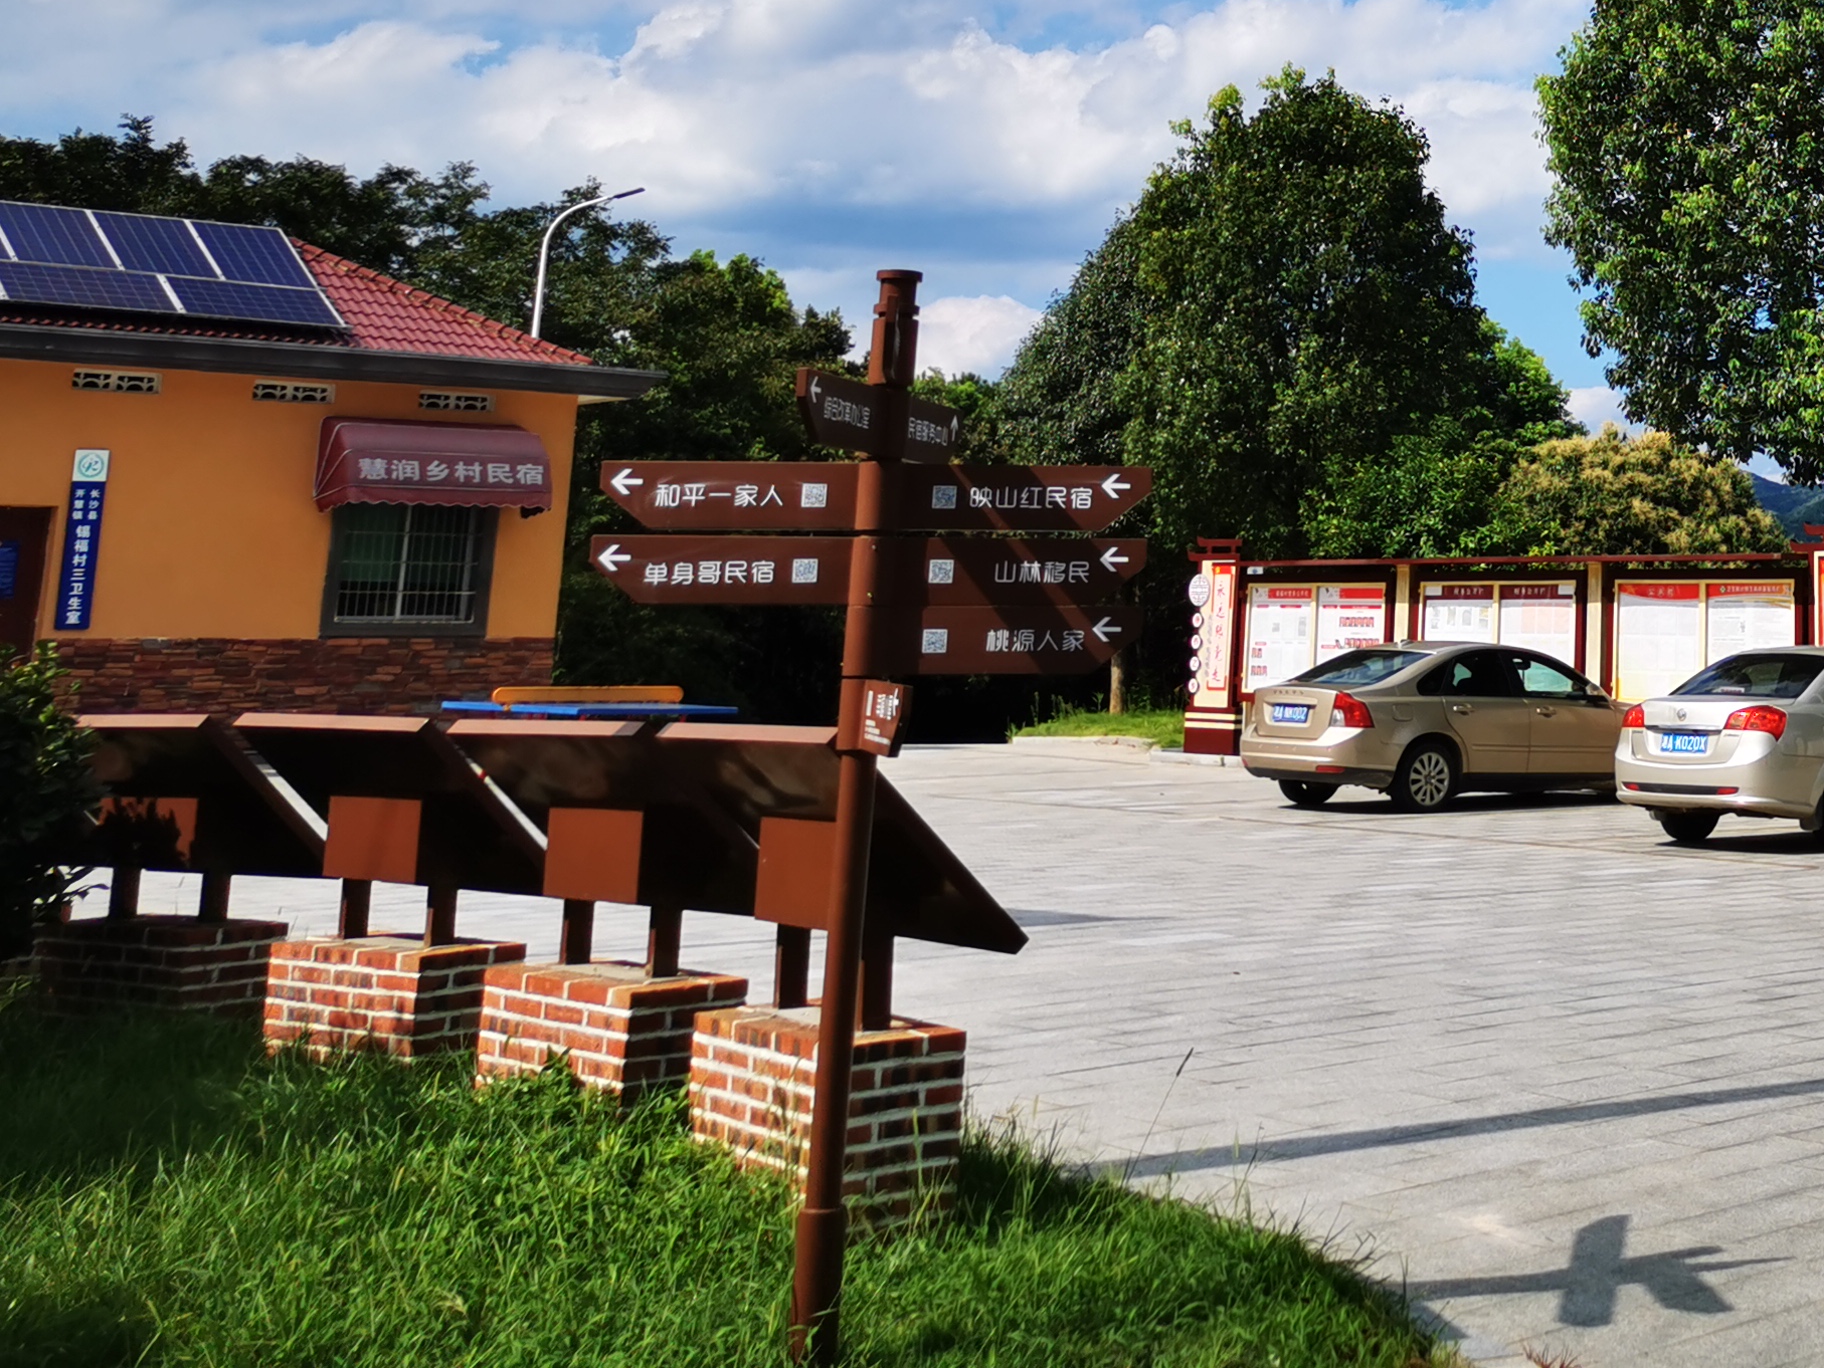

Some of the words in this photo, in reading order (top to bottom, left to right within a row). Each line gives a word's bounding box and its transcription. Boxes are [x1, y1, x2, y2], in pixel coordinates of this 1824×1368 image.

[908, 417, 949, 447] 民宿服务中心
[358, 457, 545, 485] 慧润乡村民宿
[654, 483, 784, 508] 和平一家人
[969, 486, 1093, 509] 映山红民宿
[643, 560, 775, 585] 单身哥民宿
[994, 560, 1090, 583] 山林移民
[985, 629, 1085, 652] 桃源人家
